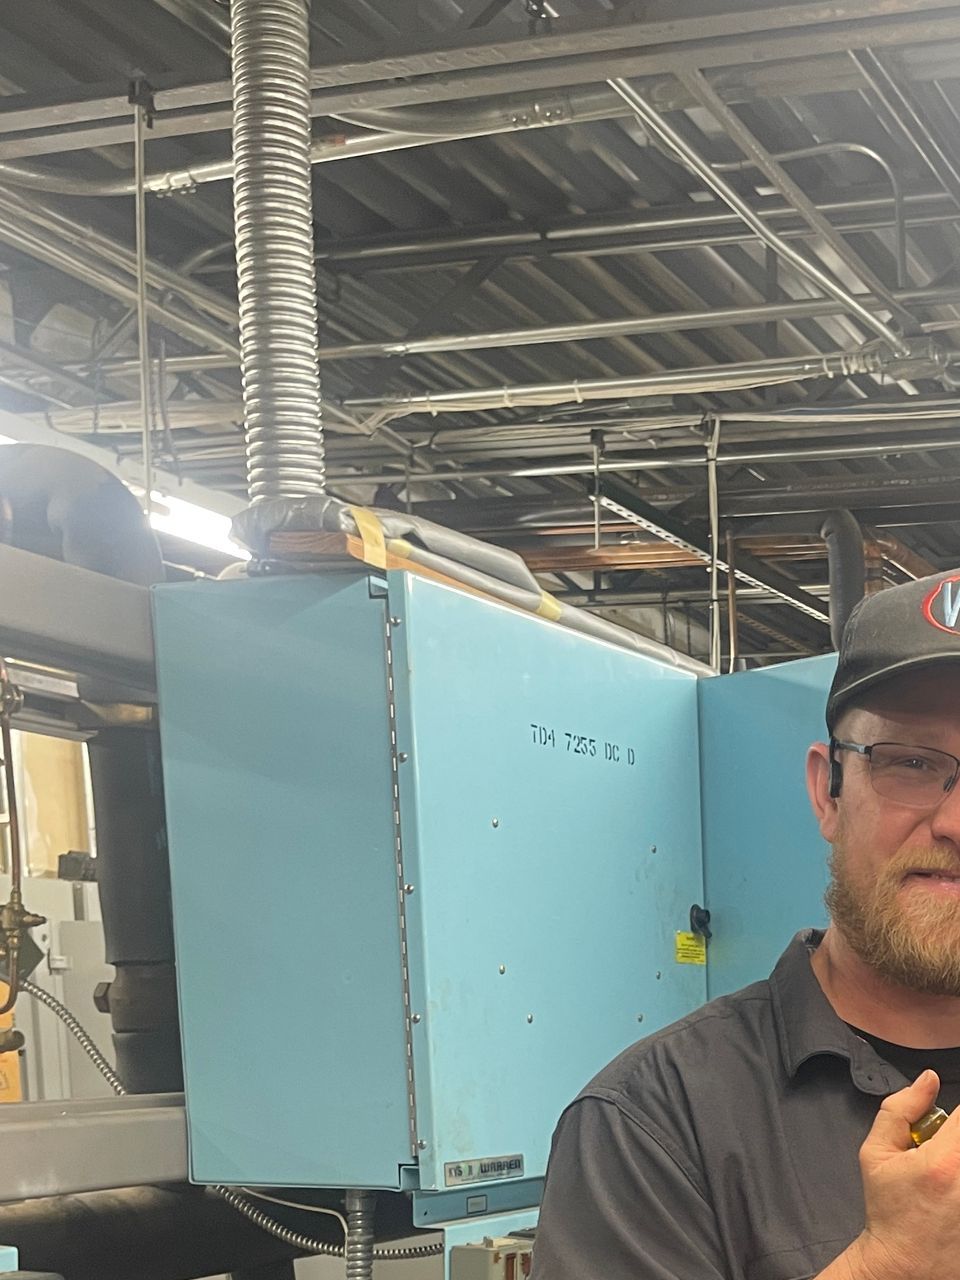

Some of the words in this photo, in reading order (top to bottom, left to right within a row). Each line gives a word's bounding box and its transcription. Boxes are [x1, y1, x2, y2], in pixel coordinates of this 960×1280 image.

[564, 732, 597, 757] 7255
[604, 742, 620, 762] DC
[627, 747, 635, 765] D
